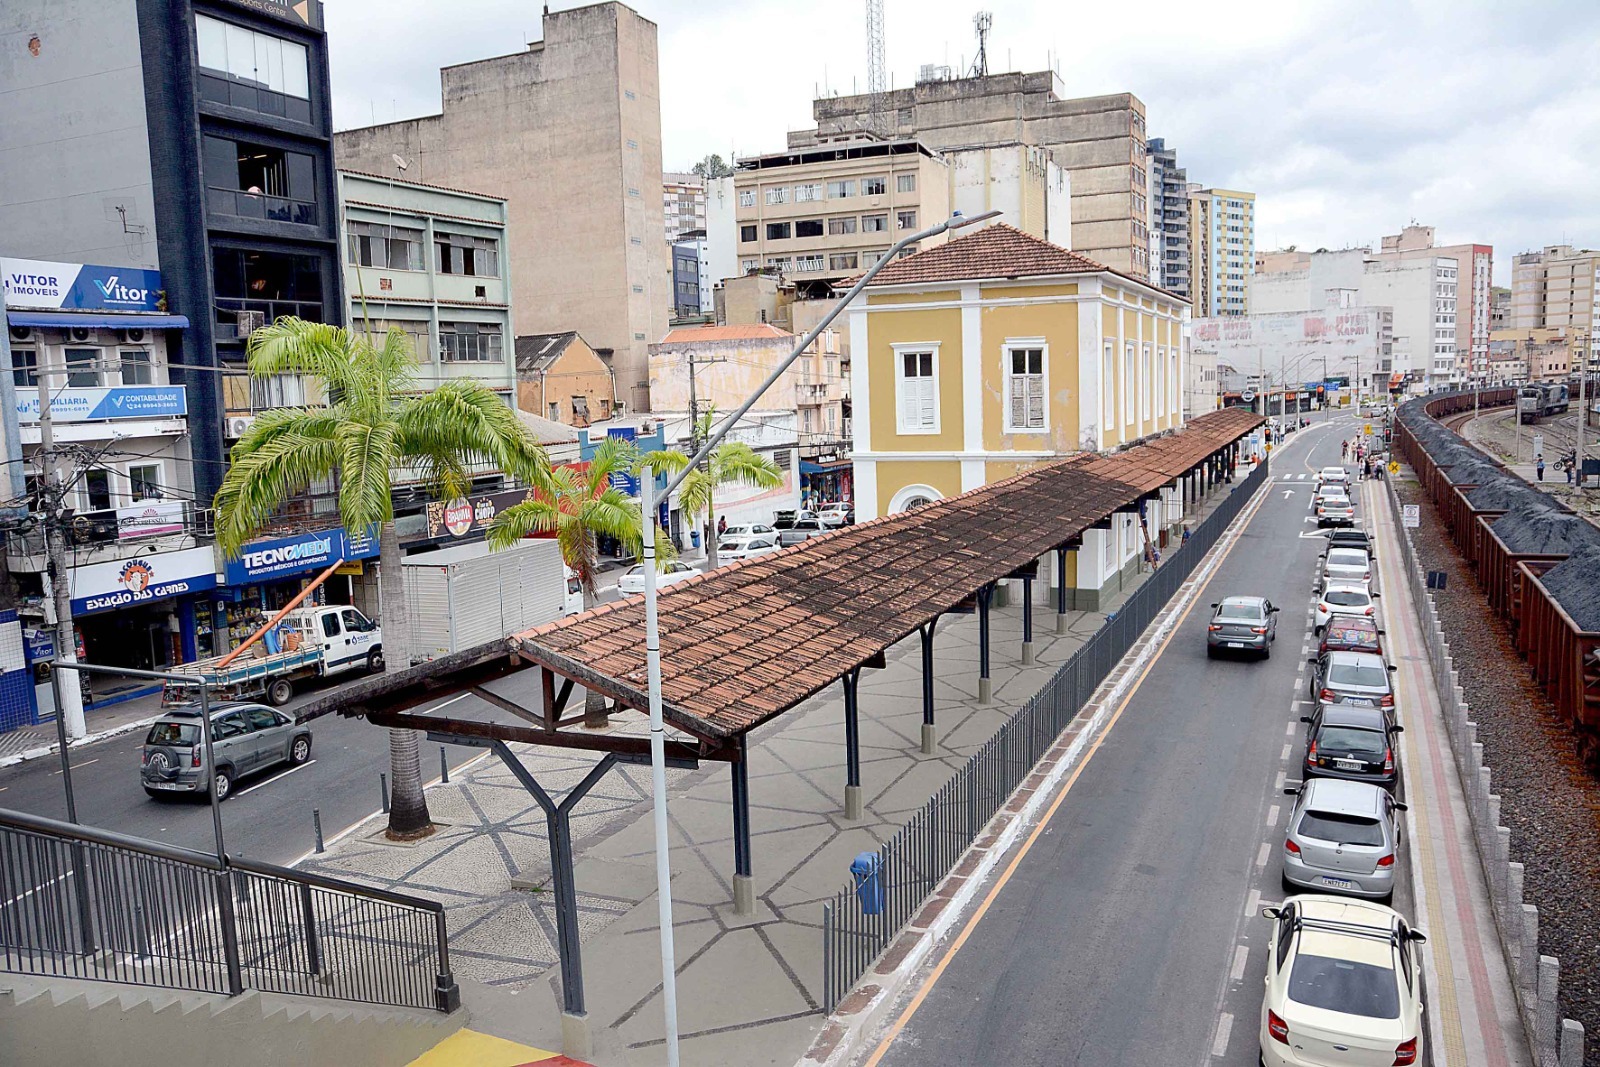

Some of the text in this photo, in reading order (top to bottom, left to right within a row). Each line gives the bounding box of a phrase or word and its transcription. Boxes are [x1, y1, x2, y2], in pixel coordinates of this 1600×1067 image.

[264, 2, 287, 16] Center
[12, 273, 58, 287] VITOR
[13, 285, 59, 297] IMÓVEIS
[93, 275, 148, 301] Vitor
[32, 397, 88, 406] IBILIÁRIA
[125, 394, 177, 402] CONTABILIDADE
[447, 507, 471, 523] BRAHMA
[474, 505, 496, 520] CHOPP
[119, 559, 152, 577] AÇOUGUE
[248, 566, 274, 576] PRODUTOS
[274, 562, 294, 571] MÉDICOS
[298, 555, 328, 566] ORTOPÉDICOS
[86, 582, 189, 610] ESTAÇÃO DAS CARNES
